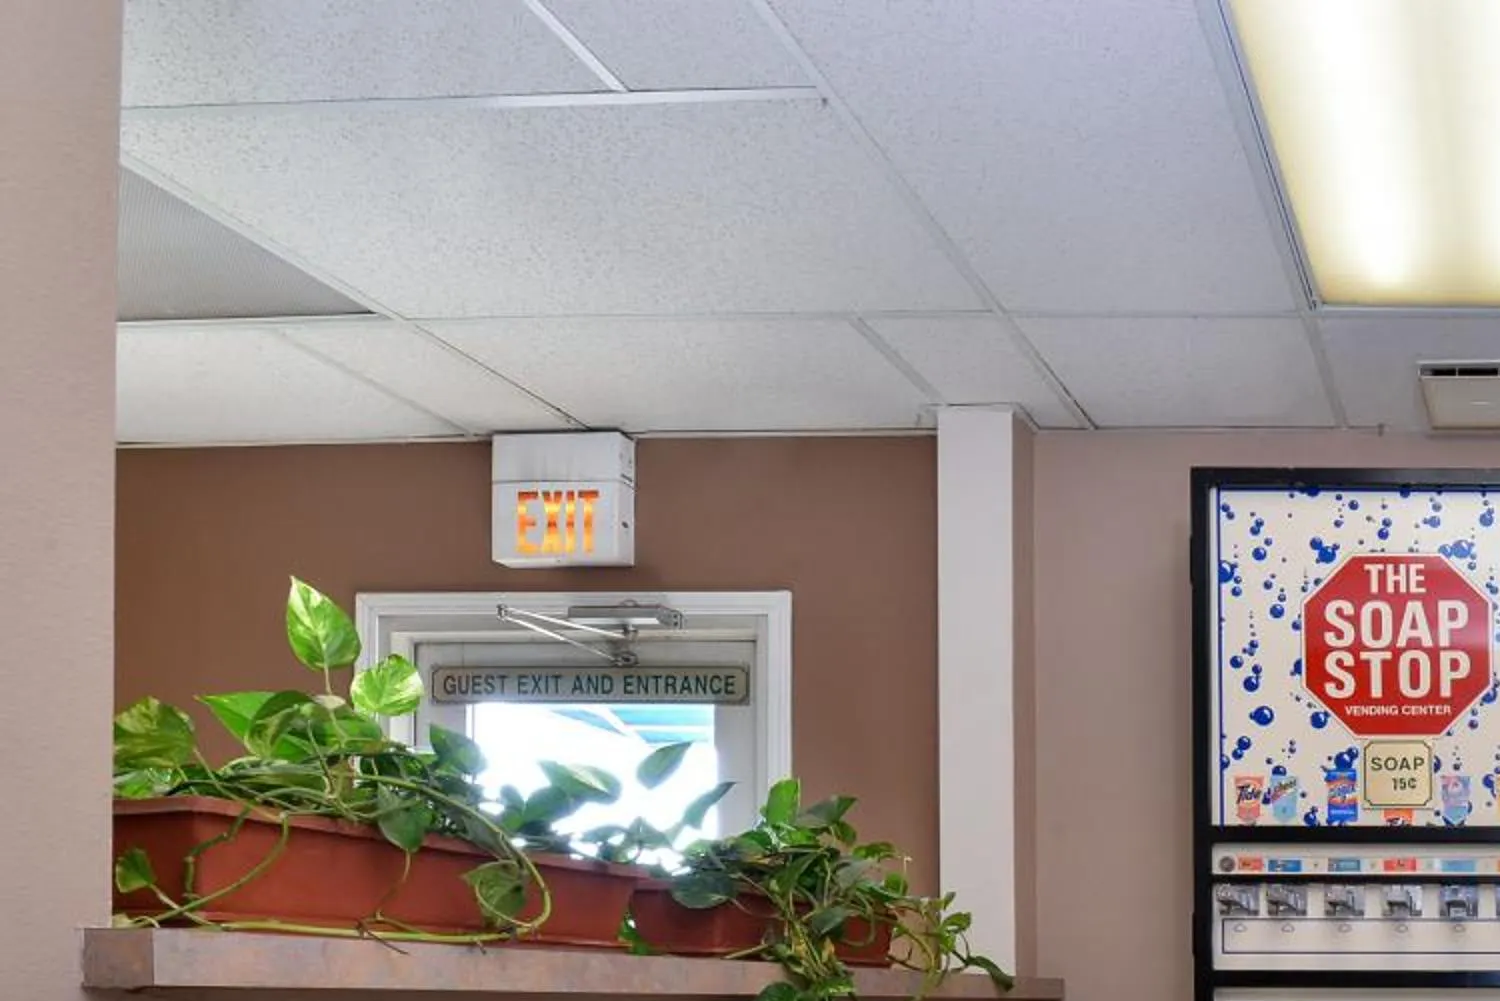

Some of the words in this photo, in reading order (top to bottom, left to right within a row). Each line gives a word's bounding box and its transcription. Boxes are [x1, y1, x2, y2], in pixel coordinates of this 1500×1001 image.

[516, 489, 600, 555] EXIT
[1364, 564, 1427, 594] THE
[1323, 600, 1469, 649] SOAP
[443, 675, 508, 695] GUEST
[517, 675, 563, 695] EXIT
[571, 675, 613, 694] AND
[623, 675, 736, 694] ENTRANCE
[1323, 651, 1472, 698] STOP
[1344, 705, 1399, 716] VENDING
[1401, 704, 1452, 715] CENTER
[1371, 756, 1425, 771] SOAP
